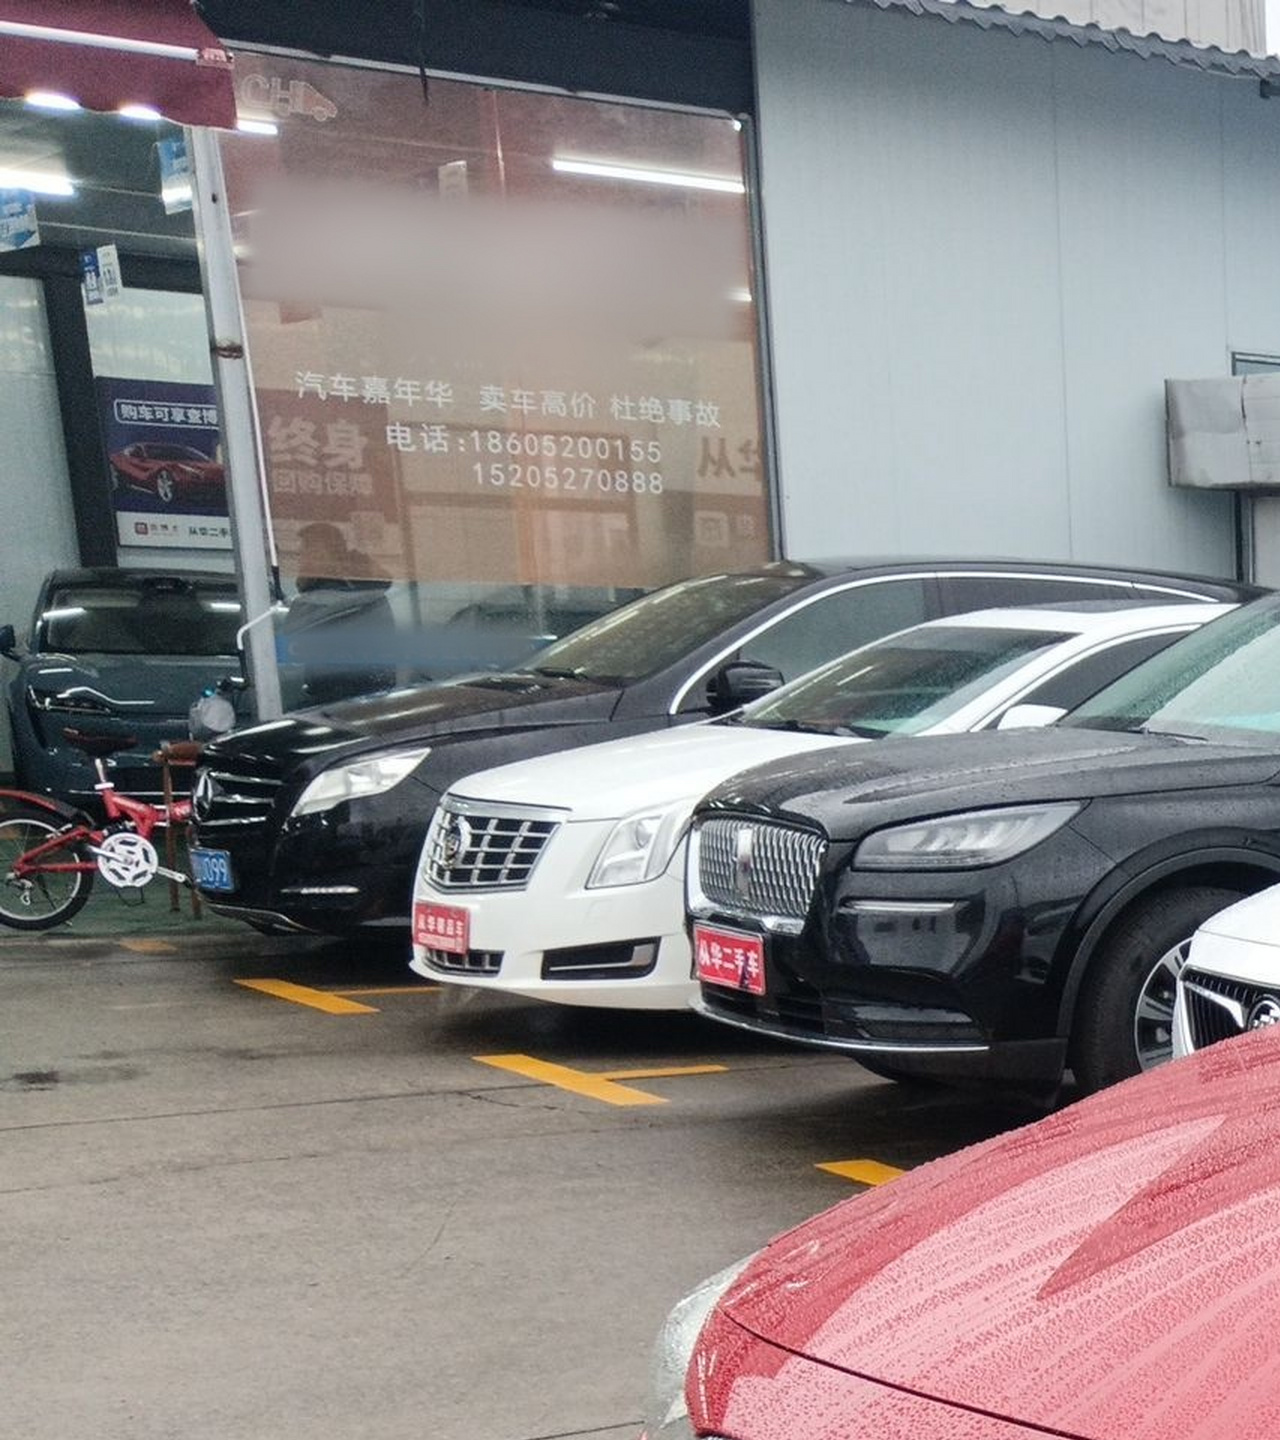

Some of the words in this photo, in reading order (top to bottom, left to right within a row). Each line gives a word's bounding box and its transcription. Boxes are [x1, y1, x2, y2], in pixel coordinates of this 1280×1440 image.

[295, 371, 453, 407] 汽车嘉年华
[480, 384, 596, 419] 卖车高价
[610, 394, 721, 428] 杜绝事故
[473, 461, 664, 494] 15205270888
[698, 939, 760, 978] 从华二手车
